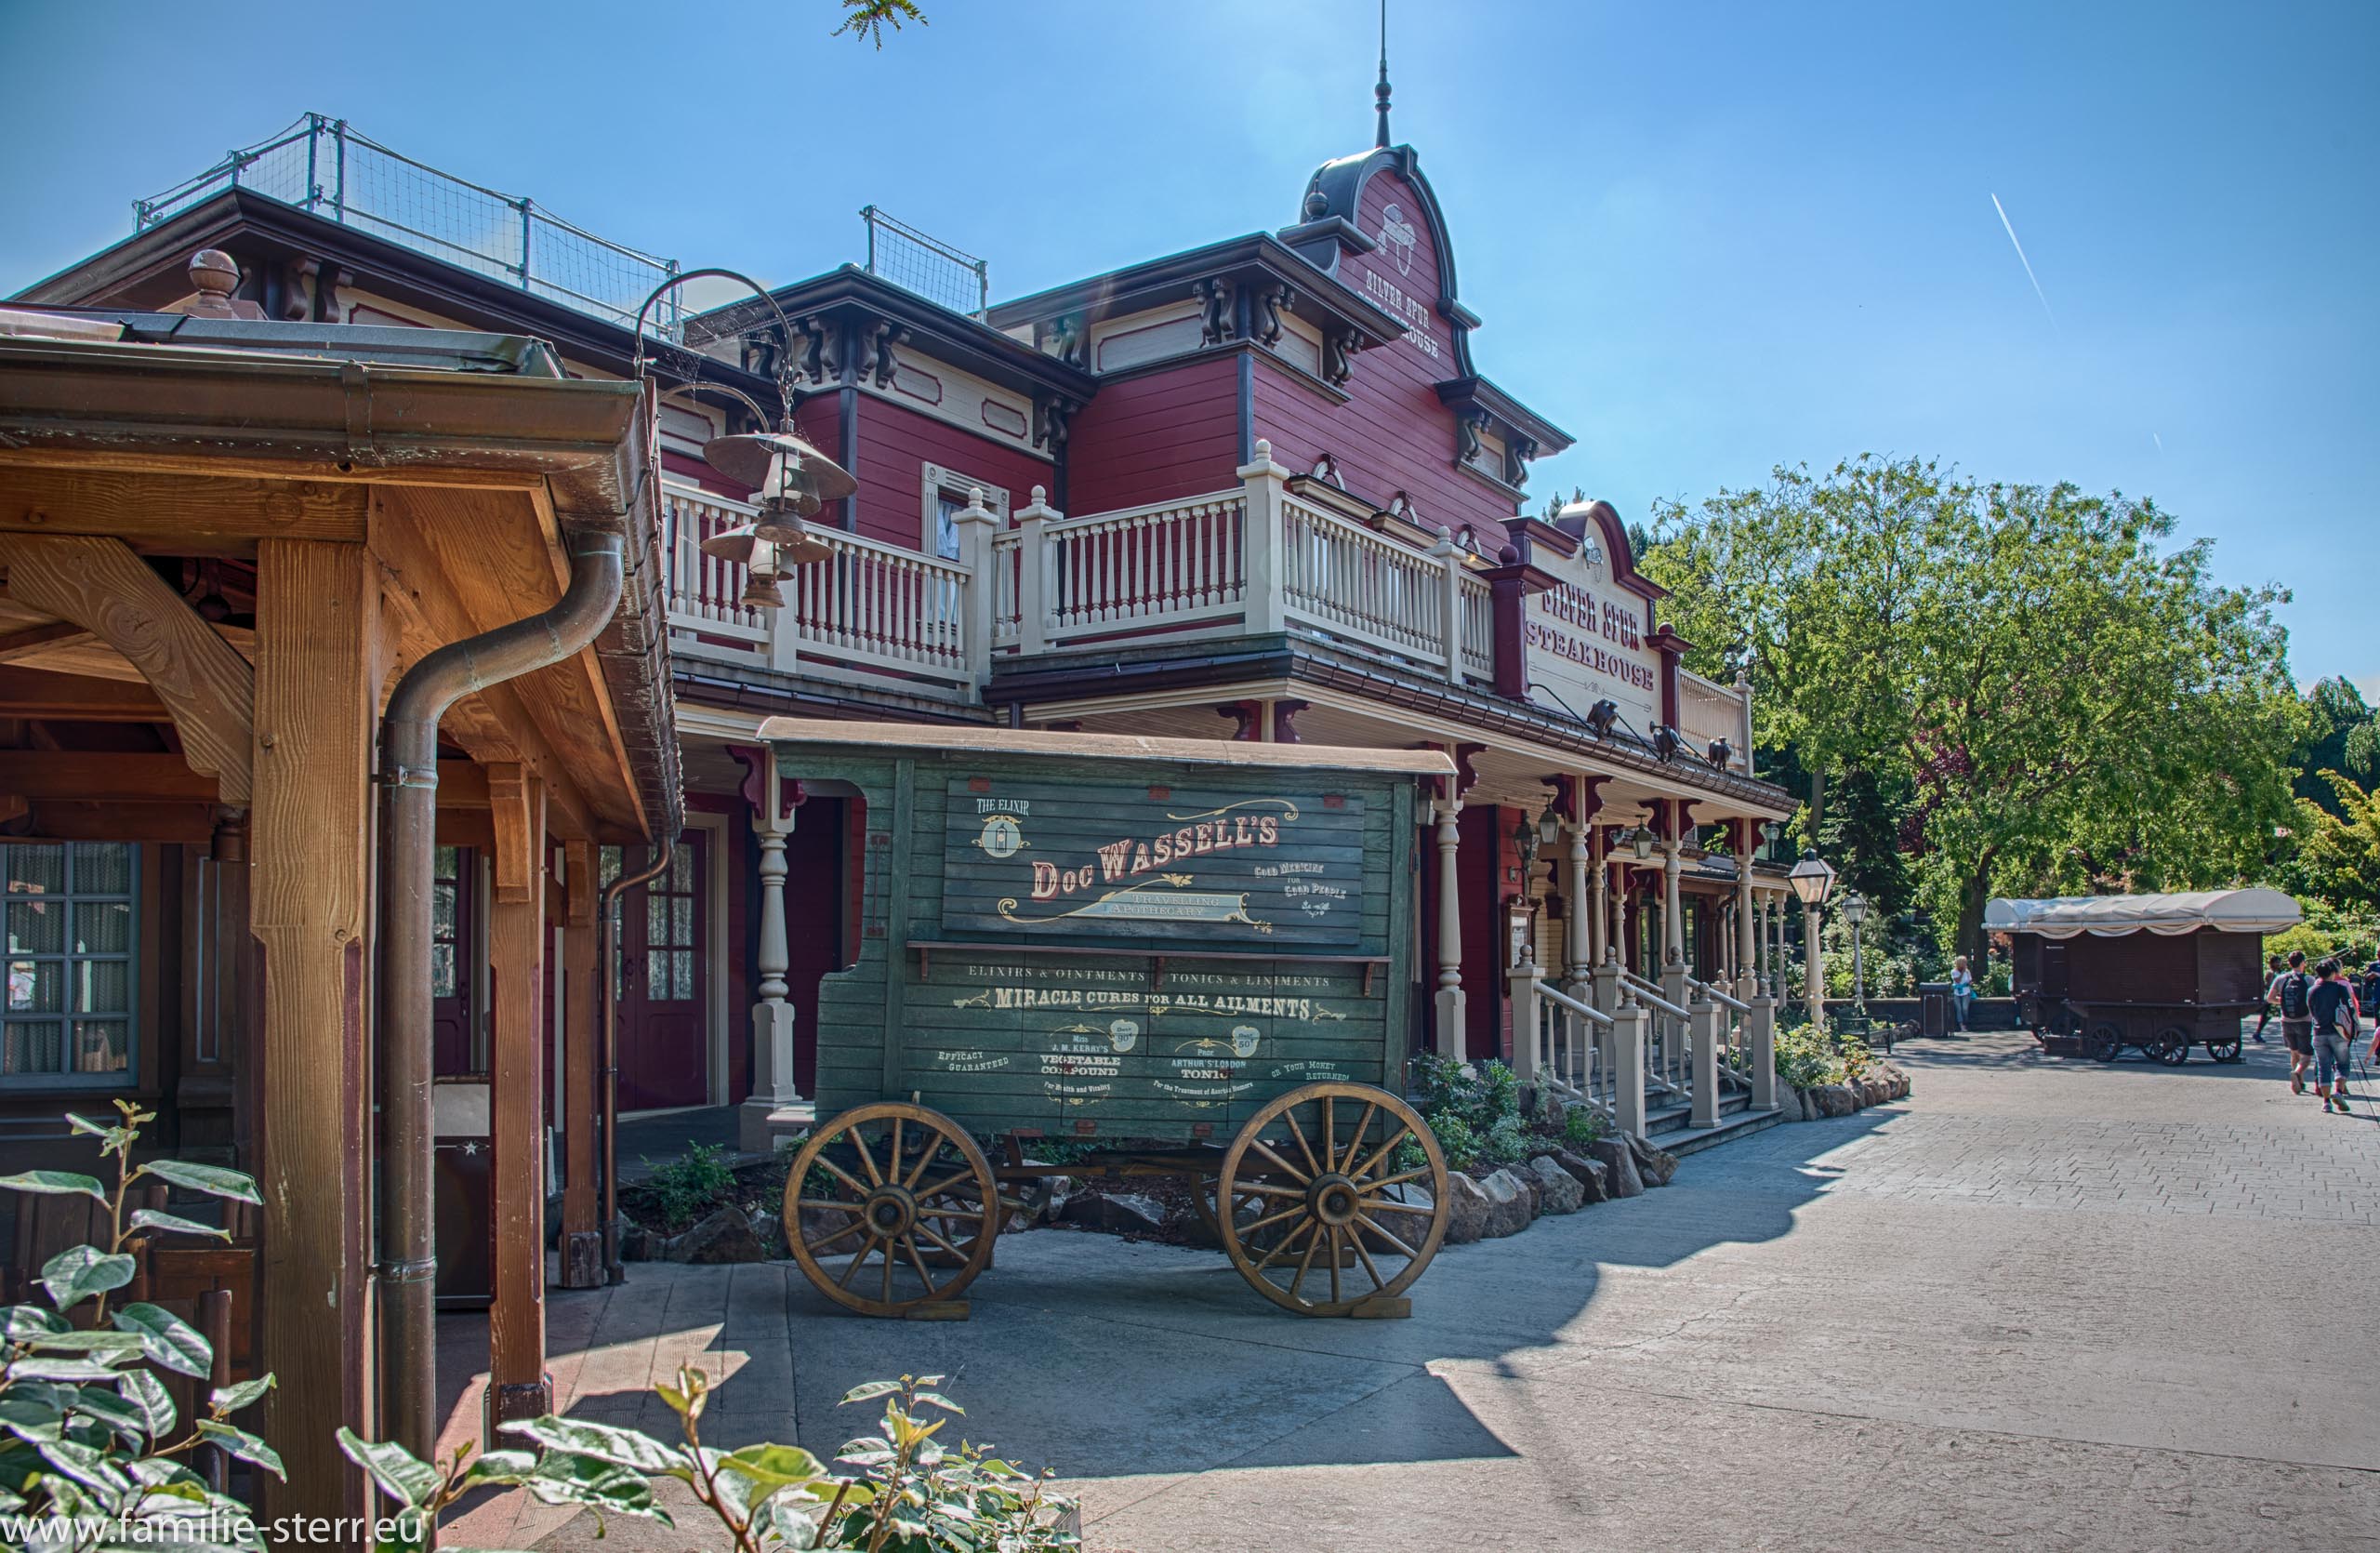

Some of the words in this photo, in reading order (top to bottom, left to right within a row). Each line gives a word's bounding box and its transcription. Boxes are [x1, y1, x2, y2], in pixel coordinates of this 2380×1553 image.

[1367, 269, 1403, 311] SILVER
[1406, 296, 1430, 330] SPUR
[1542, 581, 1597, 632] SILVER
[1603, 601, 1640, 651] SPUR
[1526, 620, 1654, 692] STEAKHOUSE
[977, 798, 996, 814] THE
[998, 799, 1029, 816] ELIXIR
[1097, 816, 1279, 883] WASSELL'S
[1254, 866, 1278, 878] GOOD
[1284, 884, 1310, 897] GOOD
[1133, 894, 1220, 906] TRAVELLING
[1112, 904, 1205, 916] APOTHECARY
[969, 965, 1033, 977] ELIXIRS
[1039, 969, 1048, 977] &
[1056, 968, 1145, 982] OINTMENTS
[1170, 973, 1223, 984] TONICS
[1230, 976, 1238, 985] &
[1247, 975, 1329, 988] LINIMENTS
[995, 988, 1082, 1009] MIRACLE
[1086, 990, 1140, 1004] CURES
[1144, 993, 1170, 1004] FOR
[1174, 994, 1209, 1007] ALL
[1214, 996, 1310, 1020] AILMENTS
[1051, 1043, 1059, 1052] J.
[1073, 1044, 1109, 1053] KERRY'S
[938, 1051, 983, 1061] EFFICACY
[1040, 1055, 1121, 1066] VEGETABLE
[948, 1056, 1009, 1071] GUARANTEED
[1271, 1069, 1281, 1078] OR
[1284, 1062, 1305, 1072] YOUR
[1309, 1060, 1335, 1070] MONEY
[1305, 1072, 1350, 1081] RETURNED!
[1055, 1083, 1075, 1093] Health
[1088, 1083, 1111, 1093] Vitality
[1163, 1082, 1173, 1092] the
[1174, 1085, 1203, 1095] Treatment
[1204, 1087, 1210, 1095] of
